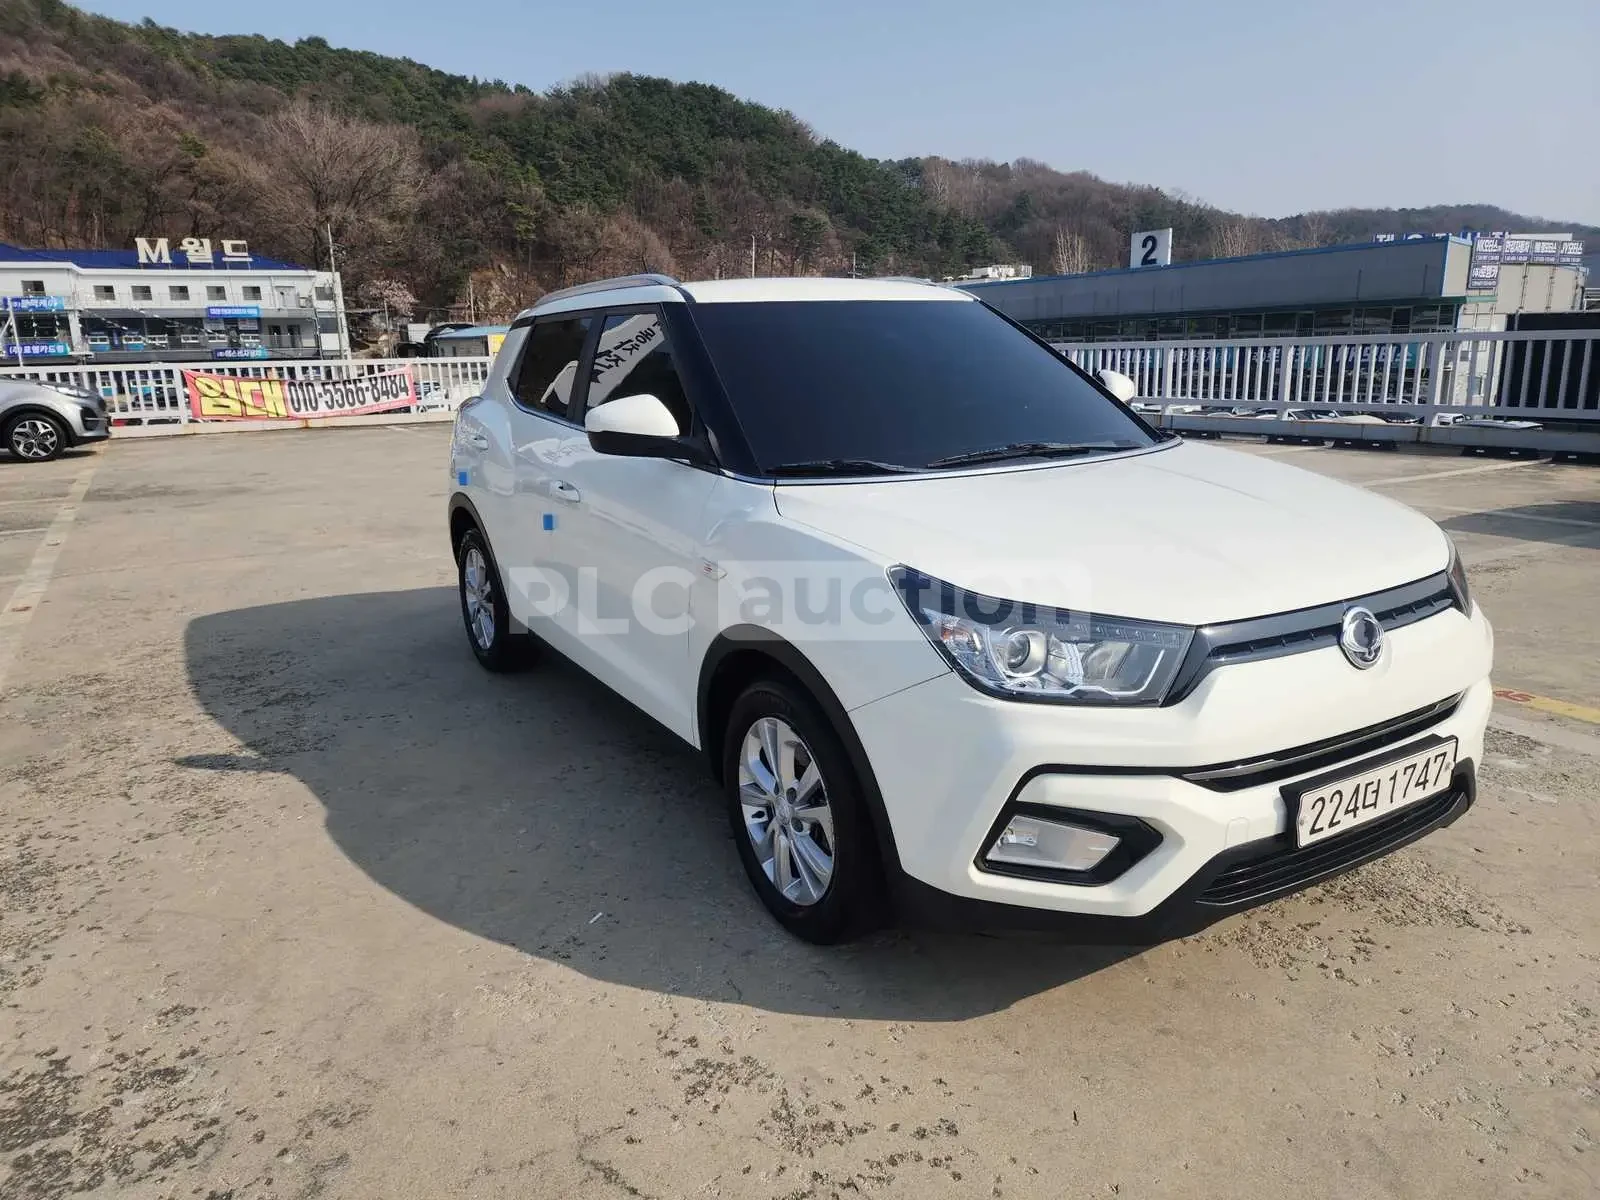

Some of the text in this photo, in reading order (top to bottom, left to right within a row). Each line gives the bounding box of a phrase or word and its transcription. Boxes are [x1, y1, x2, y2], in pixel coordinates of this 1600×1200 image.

[1140, 234, 1158, 265] 2
[195, 375, 289, 418] 임대
[287, 372, 410, 414] 010-5566-8484
[1388, 751, 1449, 805] 1747
